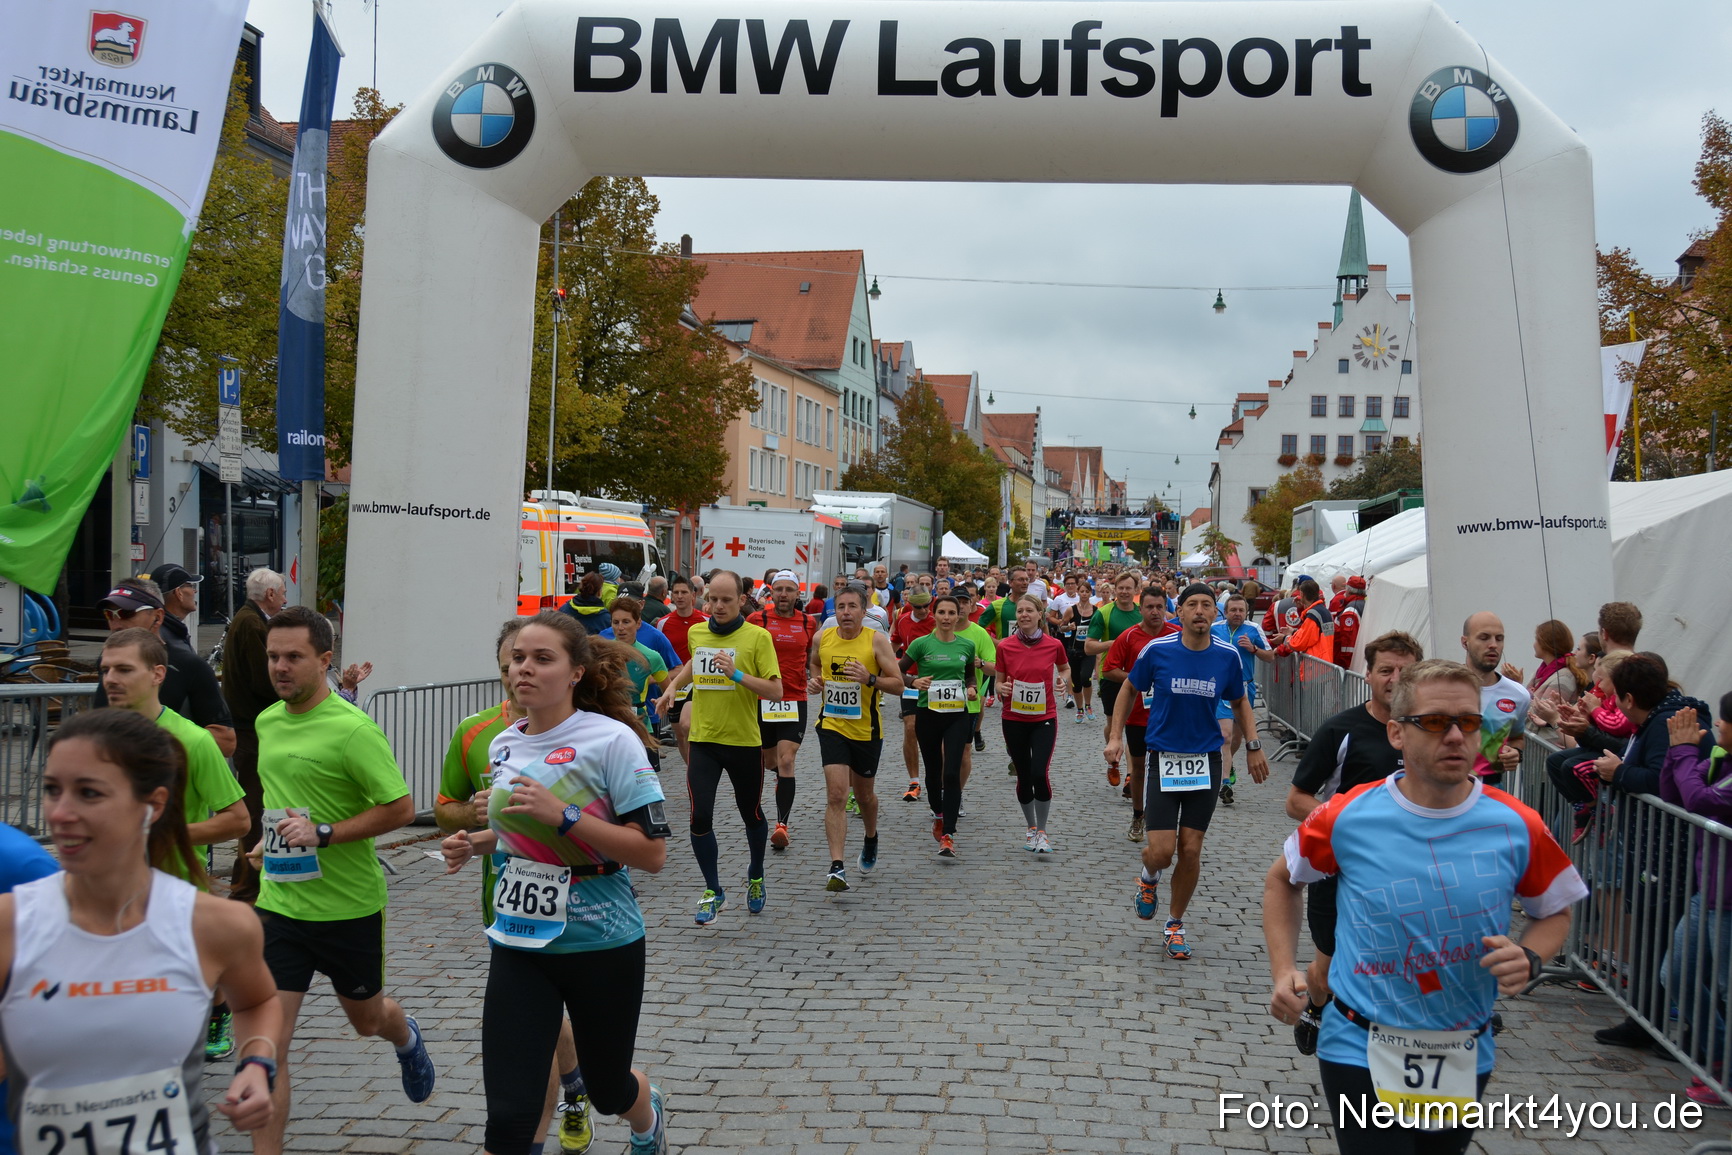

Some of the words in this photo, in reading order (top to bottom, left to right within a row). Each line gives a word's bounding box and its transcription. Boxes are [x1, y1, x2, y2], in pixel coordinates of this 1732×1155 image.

[572, 16, 851, 95] BMW
[877, 20, 1374, 118] Laufsport
[446, 65, 528, 99] BMW
[1420, 68, 1507, 103] BMW
[287, 429, 325, 447] railon
[138, 433, 147, 471] P
[169, 496, 176, 513] 3
[351, 500, 491, 521] www.bmw-laufsport.de
[1457, 515, 1607, 535] www.bmw-laufsport.de
[748, 537, 786, 546] Bayerisches
[1097, 531, 1124, 539] START
[747, 552, 766, 560] Kreuz
[700, 657, 725, 674] 16
[698, 676, 725, 684] Christian
[1171, 677, 1217, 692] HUBER
[827, 689, 858, 705] 2403
[936, 688, 957, 700] 187
[1019, 690, 1041, 703] 167
[769, 701, 791, 711] 215
[1165, 759, 1205, 776] 2192
[1172, 778, 1198, 786] Michael
[269, 859, 302, 872] Christian
[515, 867, 555, 882] Neumarkt
[497, 877, 560, 917] 2463
[567, 901, 613, 913] Neumarkter
[567, 910, 608, 922] Stadtlauf
[503, 918, 536, 935] Laura
[67, 978, 178, 998] KLEBL
[1372, 1033, 1410, 1047] PARTL
[1413, 1039, 1461, 1050] Neumarkt
[1404, 1053, 1447, 1089] 57
[25, 1101, 72, 1118] PARTL
[75, 1089, 158, 1114] Neumarkt
[37, 1107, 178, 1155] 2174
